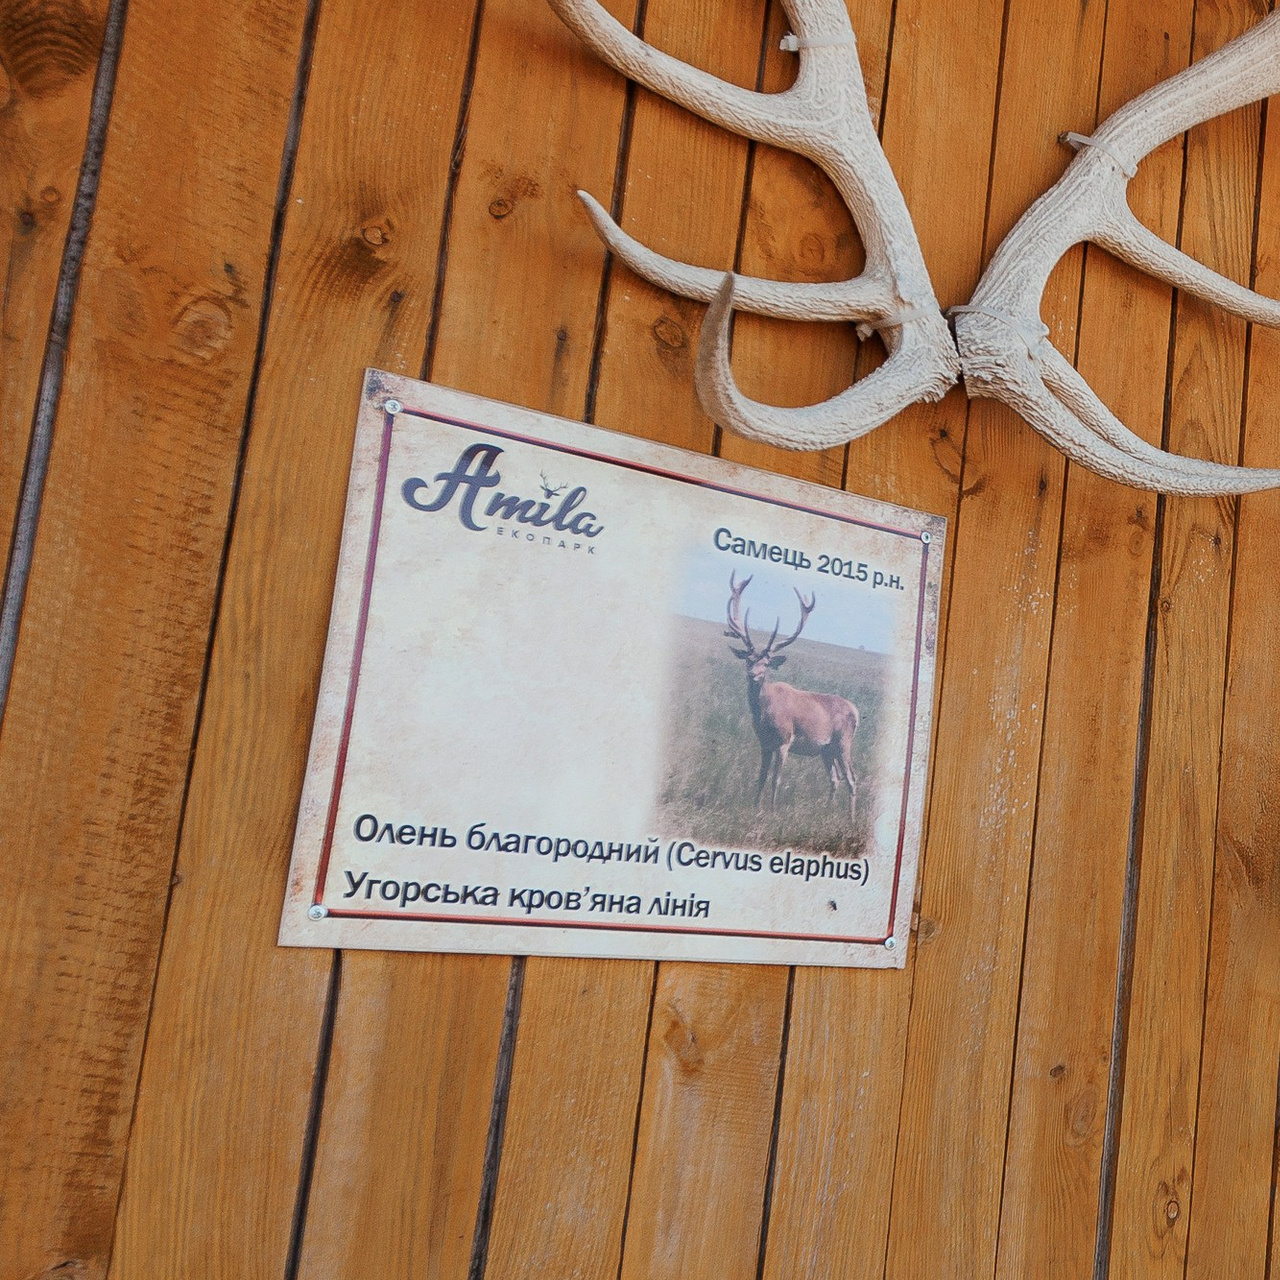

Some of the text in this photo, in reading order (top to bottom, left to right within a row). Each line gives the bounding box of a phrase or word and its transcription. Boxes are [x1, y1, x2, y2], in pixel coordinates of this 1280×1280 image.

[401, 443, 604, 538] Amila
[496, 527, 596, 555] ЕКОПАРК
[713, 527, 905, 591] Самець 2015 р.н.
[353, 813, 871, 887] Олень благородний (Cervus elaphus)
[342, 870, 711, 919] Угорська кров’яна лінія
